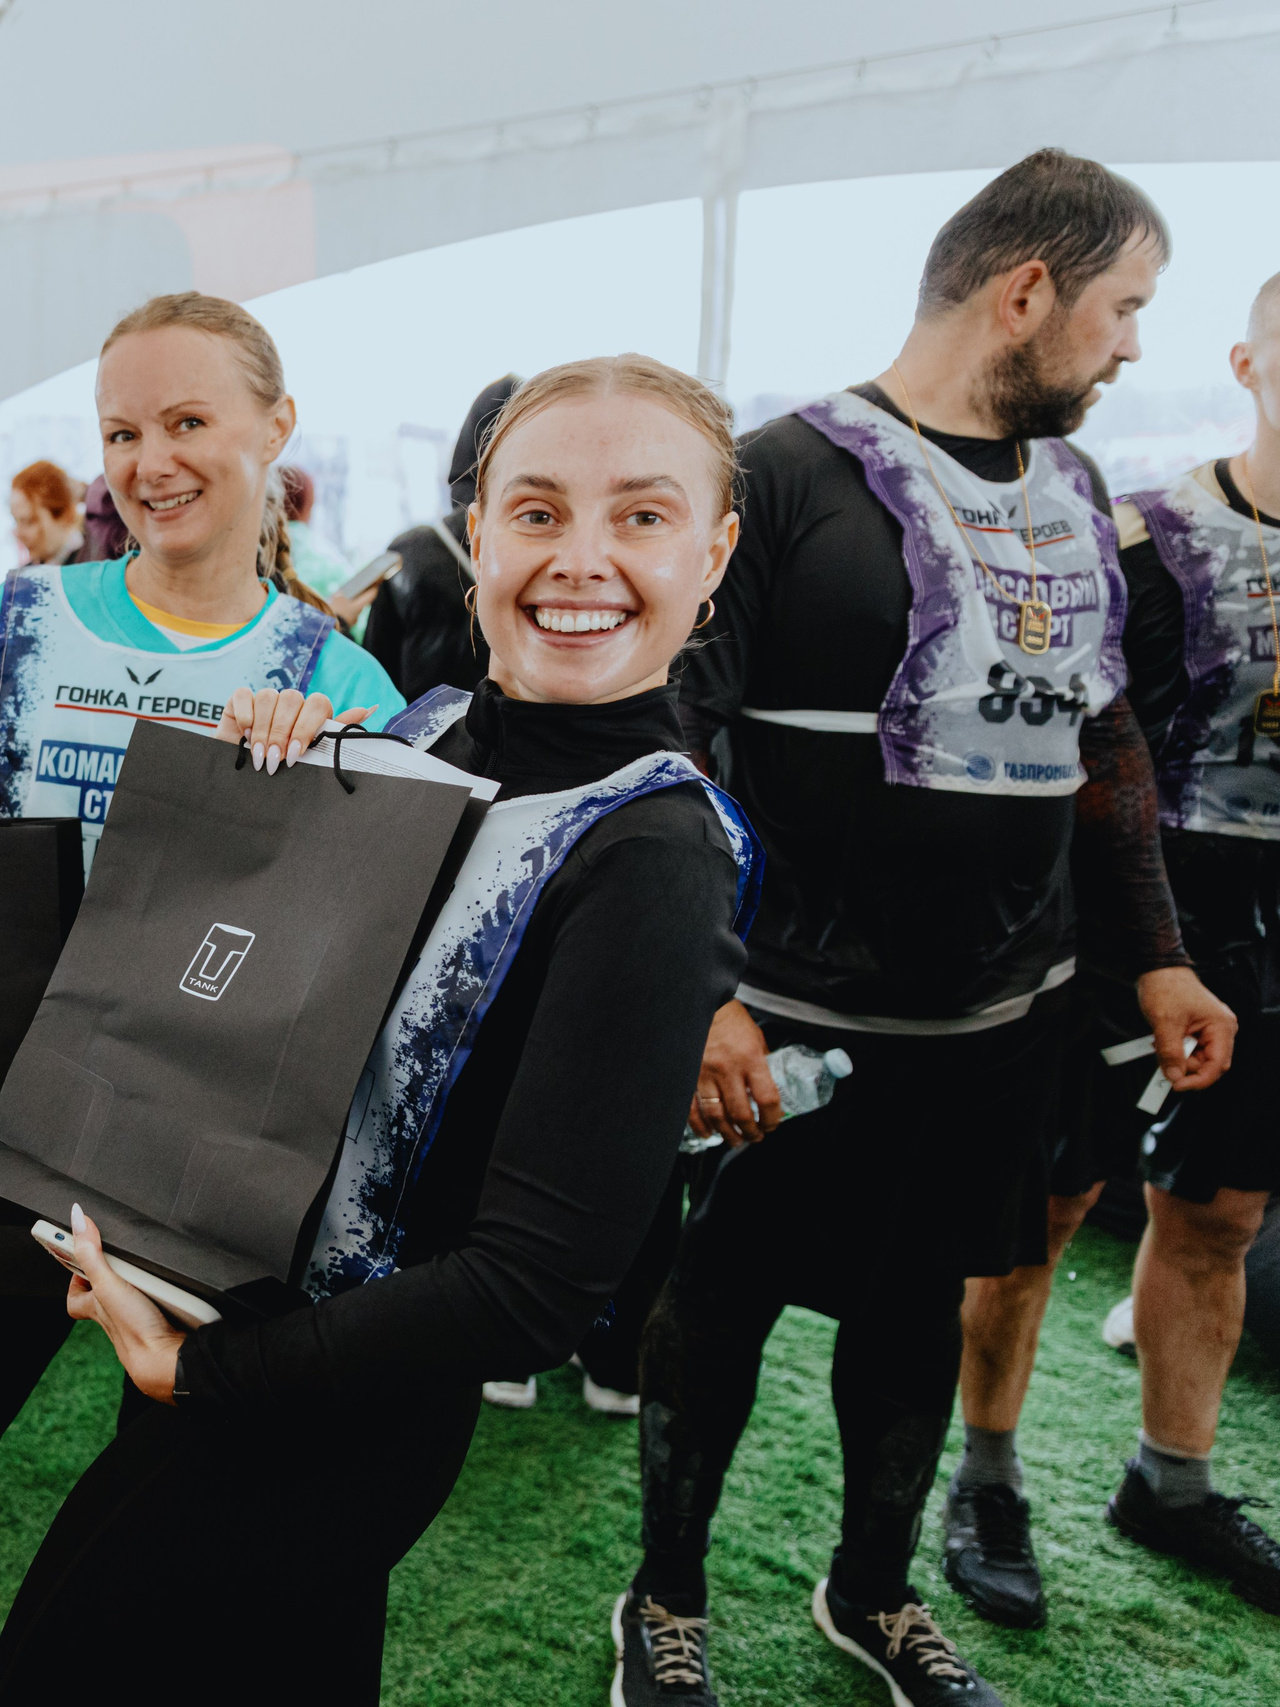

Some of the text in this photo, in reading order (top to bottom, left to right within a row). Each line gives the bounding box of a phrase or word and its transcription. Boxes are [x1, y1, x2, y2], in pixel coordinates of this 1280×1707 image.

[55, 685, 225, 722] ГОНКА ГЕРОЕВ
[189, 977, 219, 993] TANK
